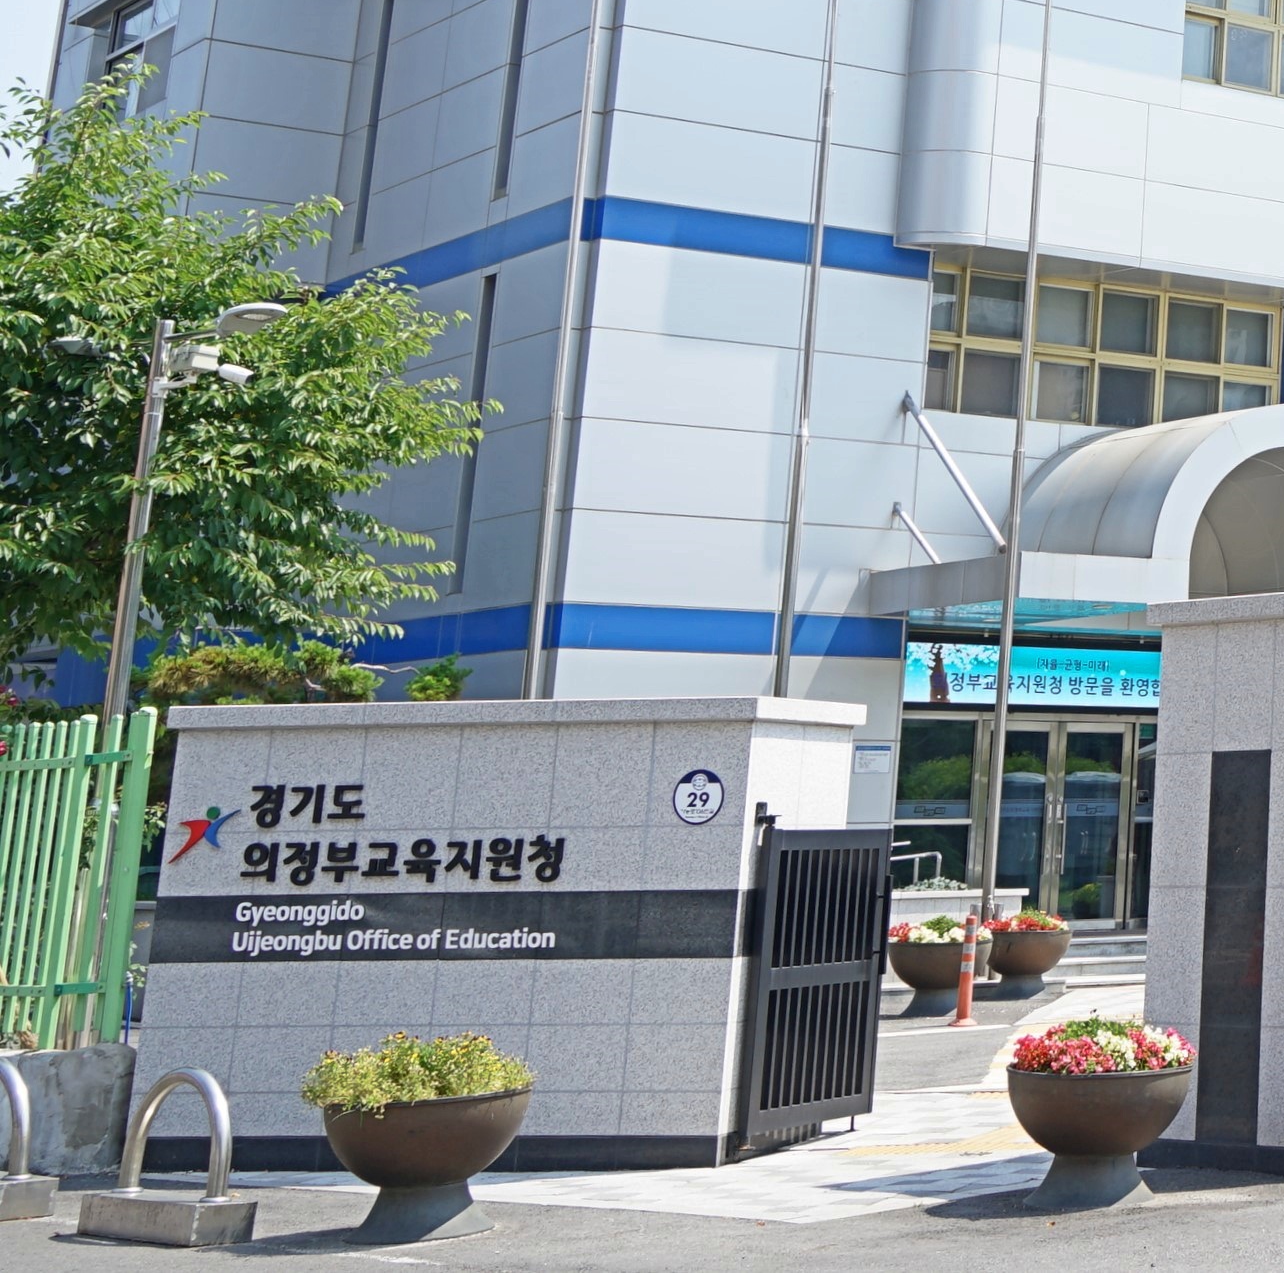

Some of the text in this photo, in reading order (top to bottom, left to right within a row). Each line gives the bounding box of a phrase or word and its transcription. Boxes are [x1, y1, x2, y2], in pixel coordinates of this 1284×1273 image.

[1068, 676, 1115, 697] 방문을
[250, 784, 366, 828] 경기도
[687, 791, 710, 808] 29
[240, 834, 566, 886] 의정부교육지원청
[235, 899, 365, 927] Gyeonggido
[232, 927, 556, 957] Uijeongbu Office of Education
